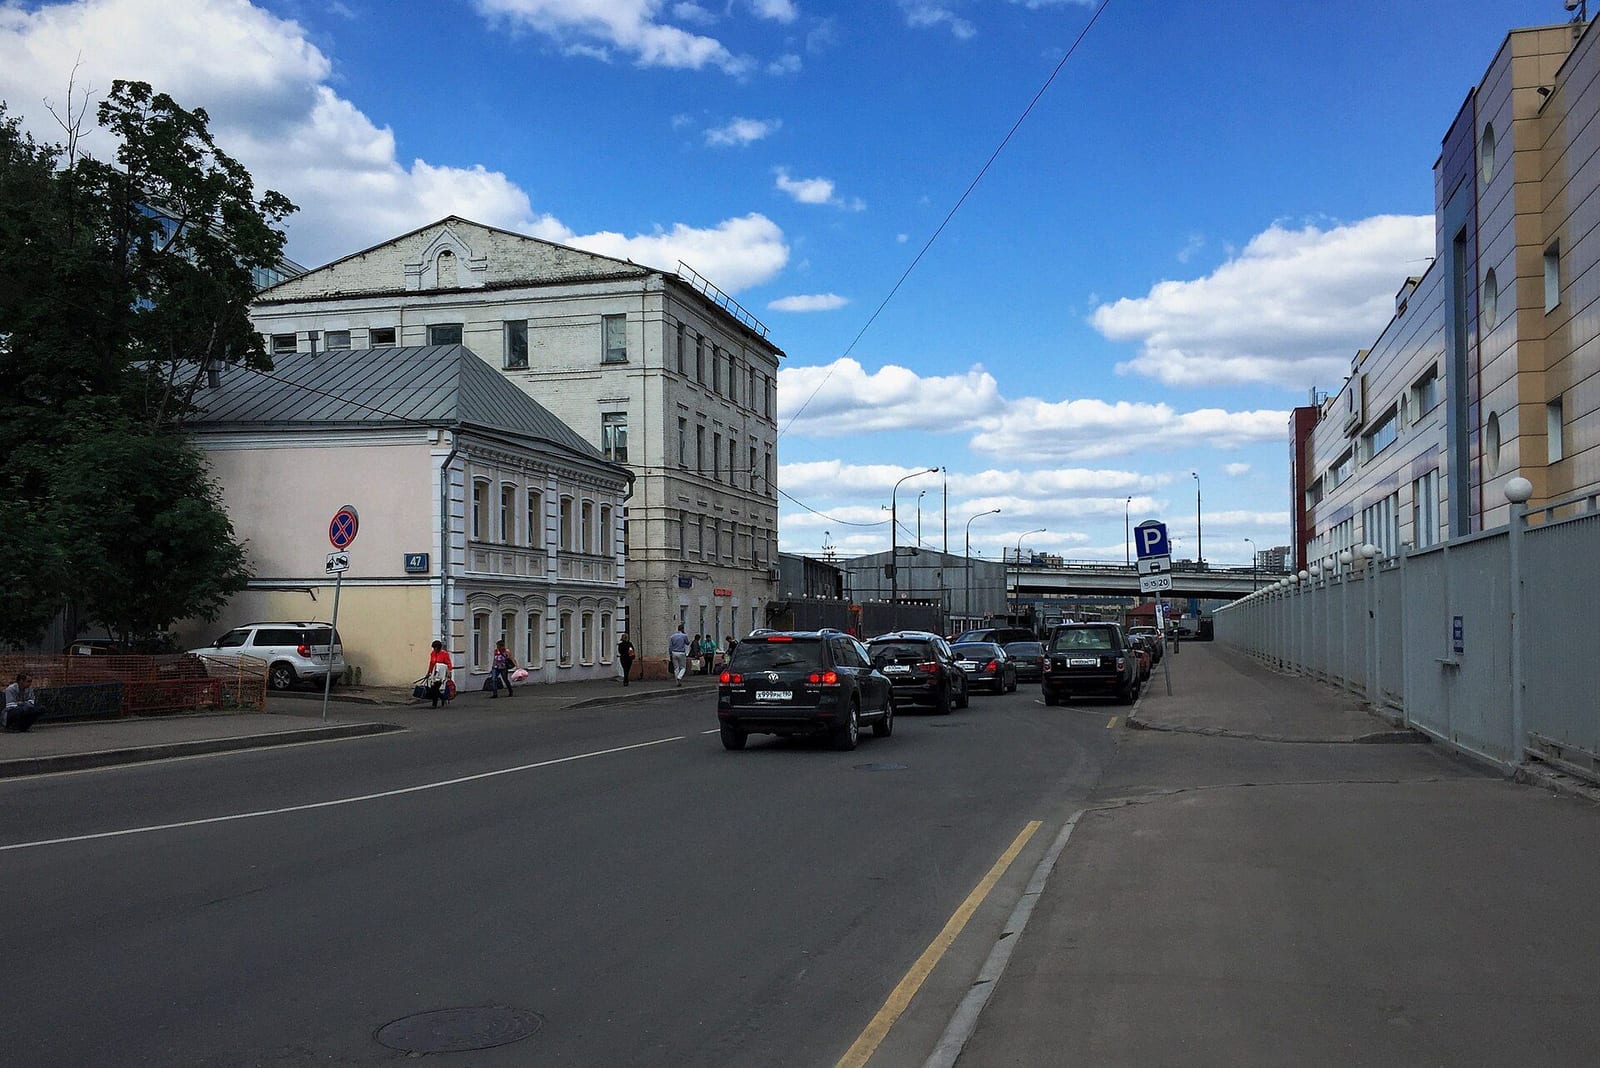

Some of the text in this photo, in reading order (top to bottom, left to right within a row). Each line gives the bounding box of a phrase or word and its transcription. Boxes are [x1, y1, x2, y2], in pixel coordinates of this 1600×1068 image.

[1143, 528, 1162, 554] P
[410, 556, 422, 567] 47
[1159, 579, 1168, 587] 20
